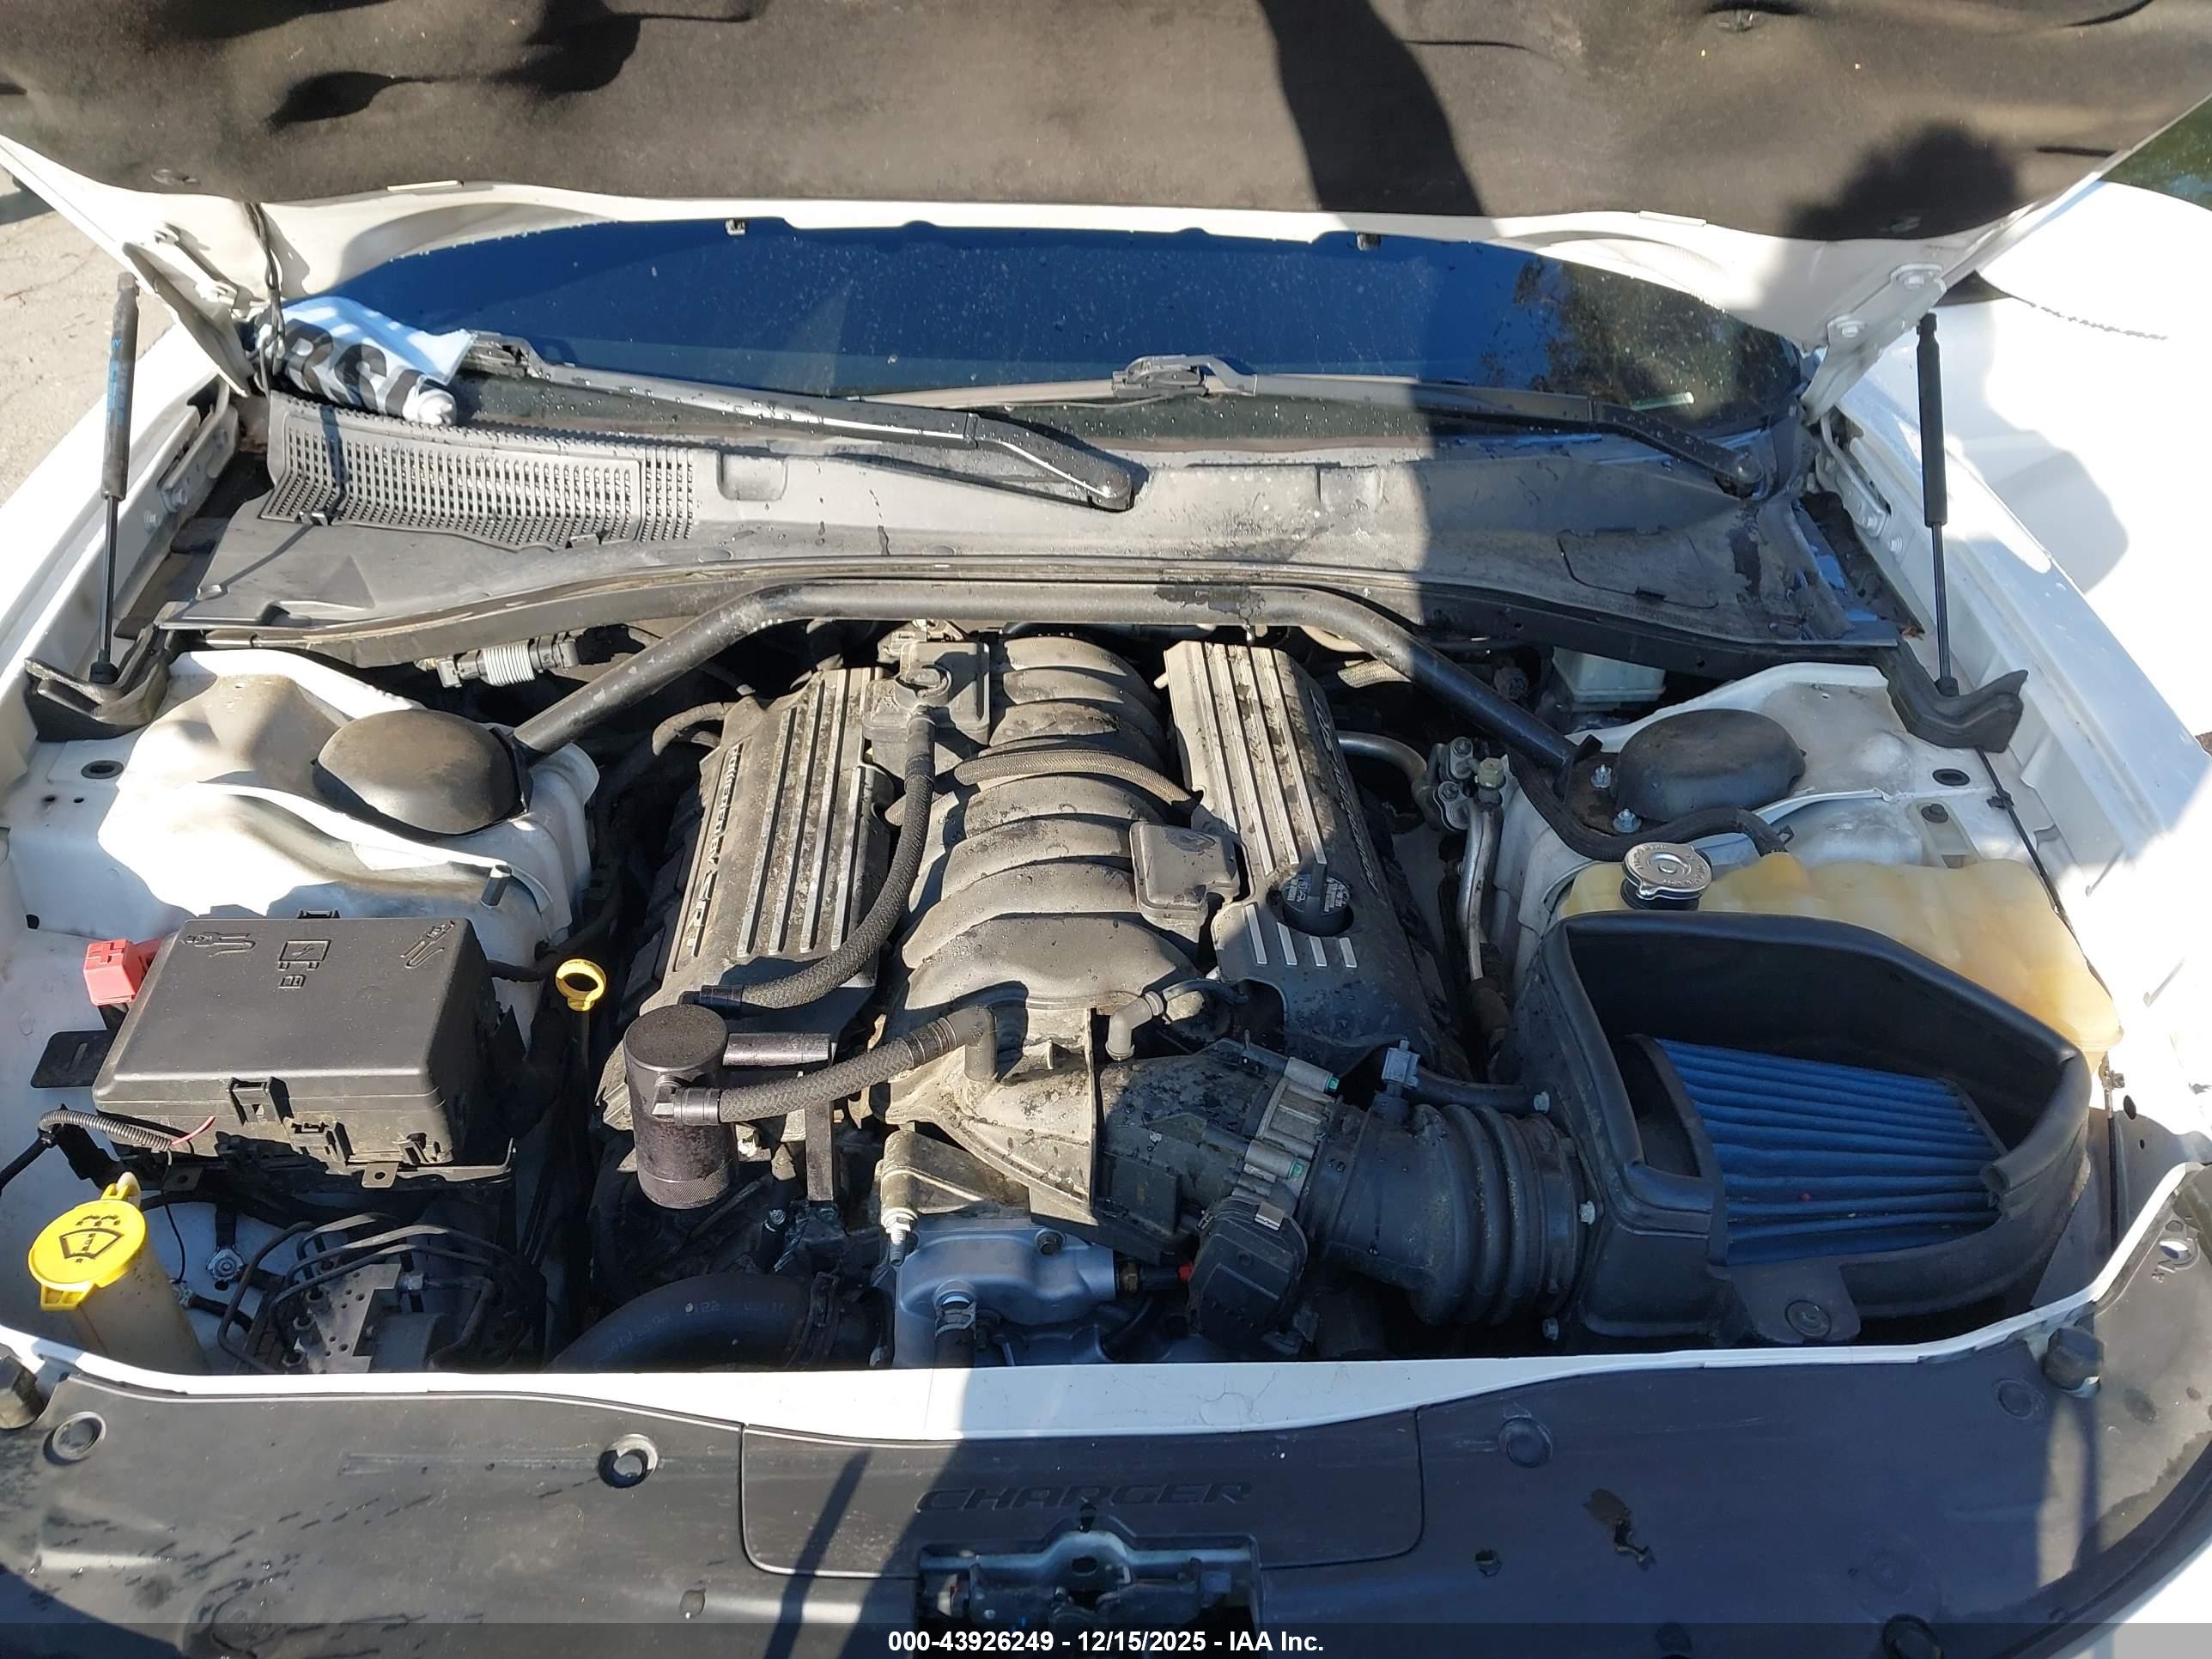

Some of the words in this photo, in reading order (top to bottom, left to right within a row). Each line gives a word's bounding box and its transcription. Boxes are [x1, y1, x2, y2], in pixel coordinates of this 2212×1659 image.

[1309, 686, 1338, 763] SRT
[712, 742, 744, 835] POWERED
[708, 835, 724, 866] BY
[687, 869, 718, 957] SRT
[915, 1483, 1252, 1513] CHARGER
